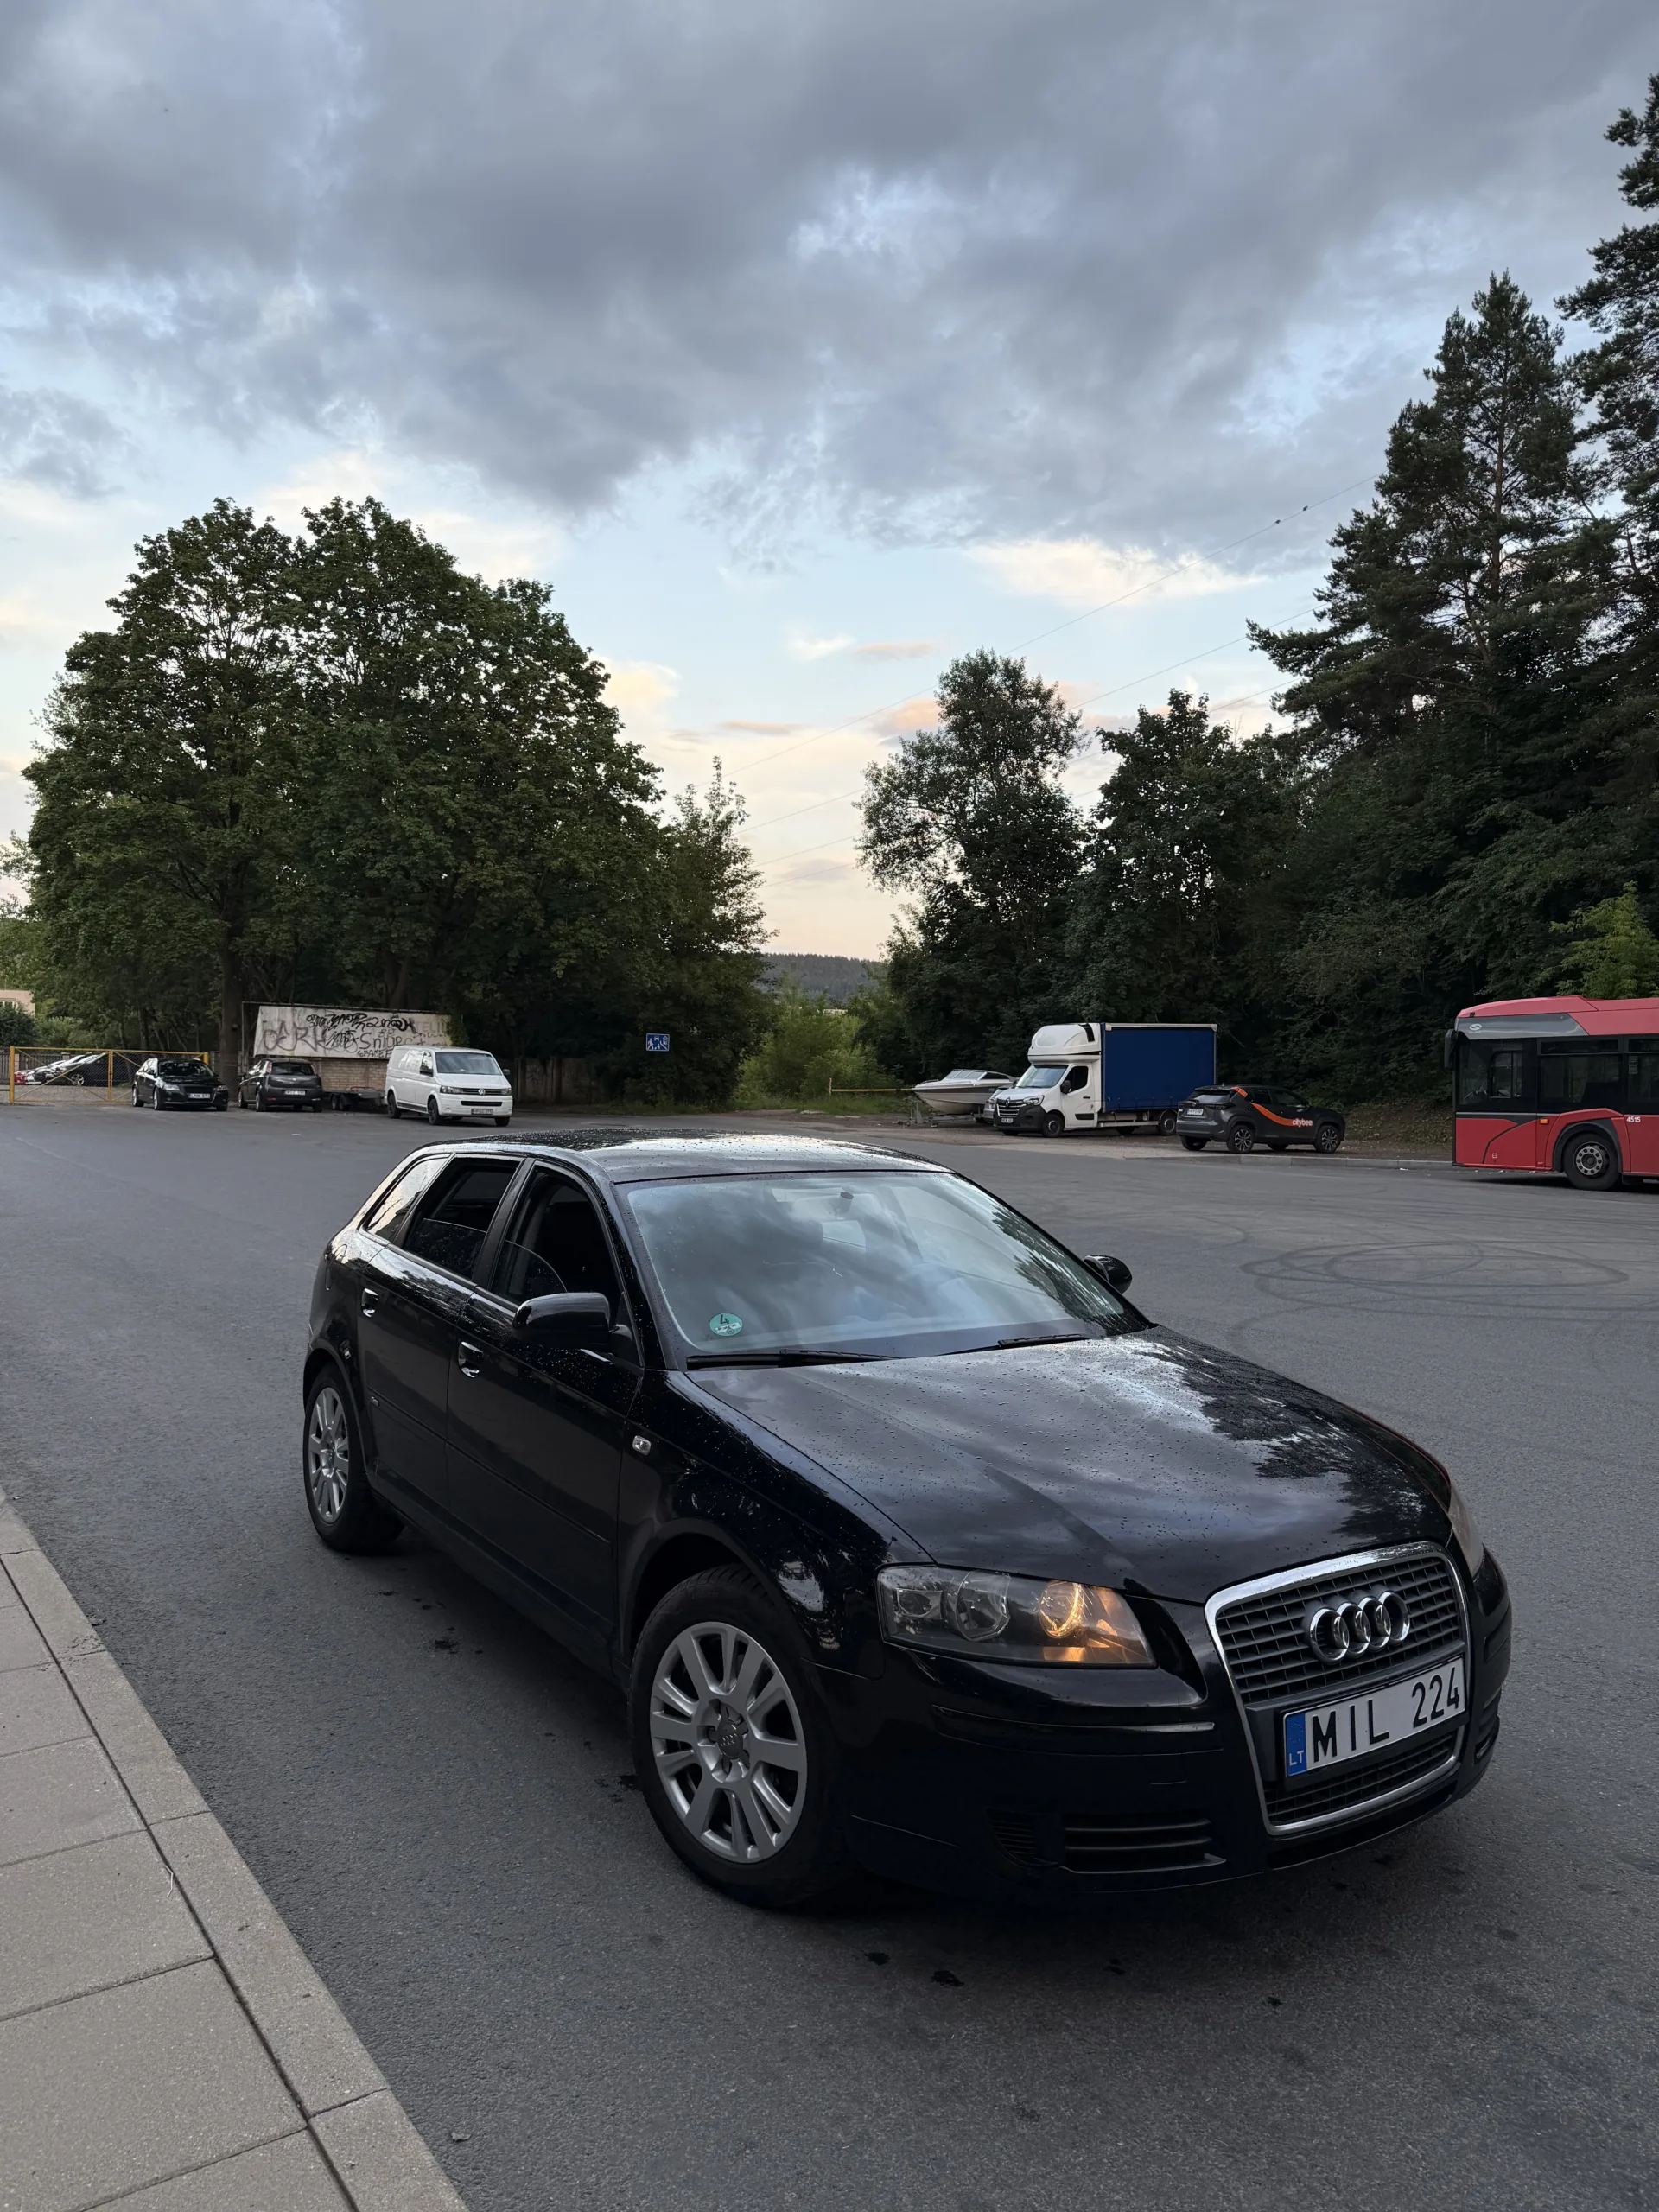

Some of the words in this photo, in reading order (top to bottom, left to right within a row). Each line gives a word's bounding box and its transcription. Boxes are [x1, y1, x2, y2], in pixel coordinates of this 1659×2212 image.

[1292, 1118, 1313, 1128] citybee
[720, 1314, 730, 1324] 4
[1312, 1699, 1390, 1763] MIL
[1411, 1666, 1460, 1728] 224
[1288, 1750, 1305, 1766] LT
